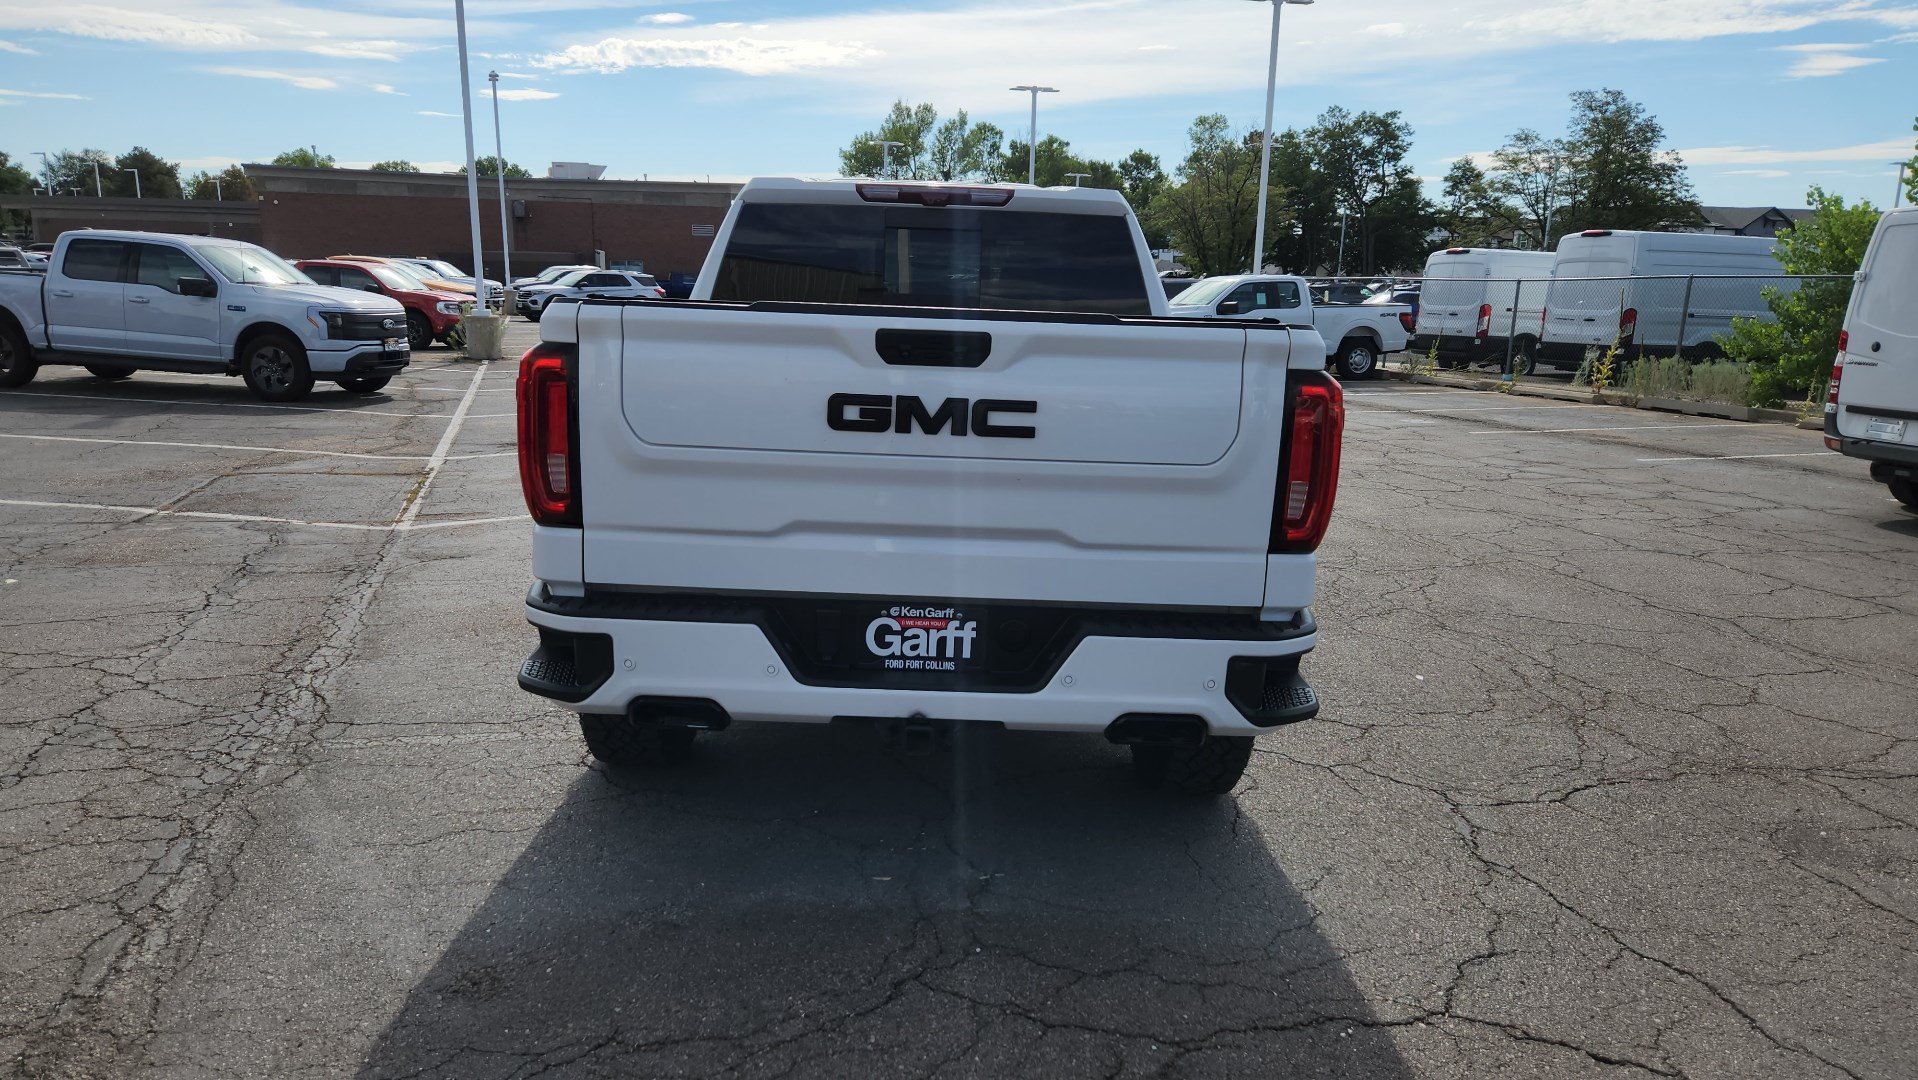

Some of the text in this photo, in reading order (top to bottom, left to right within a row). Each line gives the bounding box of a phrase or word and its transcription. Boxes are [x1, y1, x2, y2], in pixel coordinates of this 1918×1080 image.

[827, 392, 1037, 439] GMC
[901, 606, 954, 618] Ken Garff
[865, 617, 976, 659] Garff
[885, 659, 955, 671] FORD FORT COLLINS
